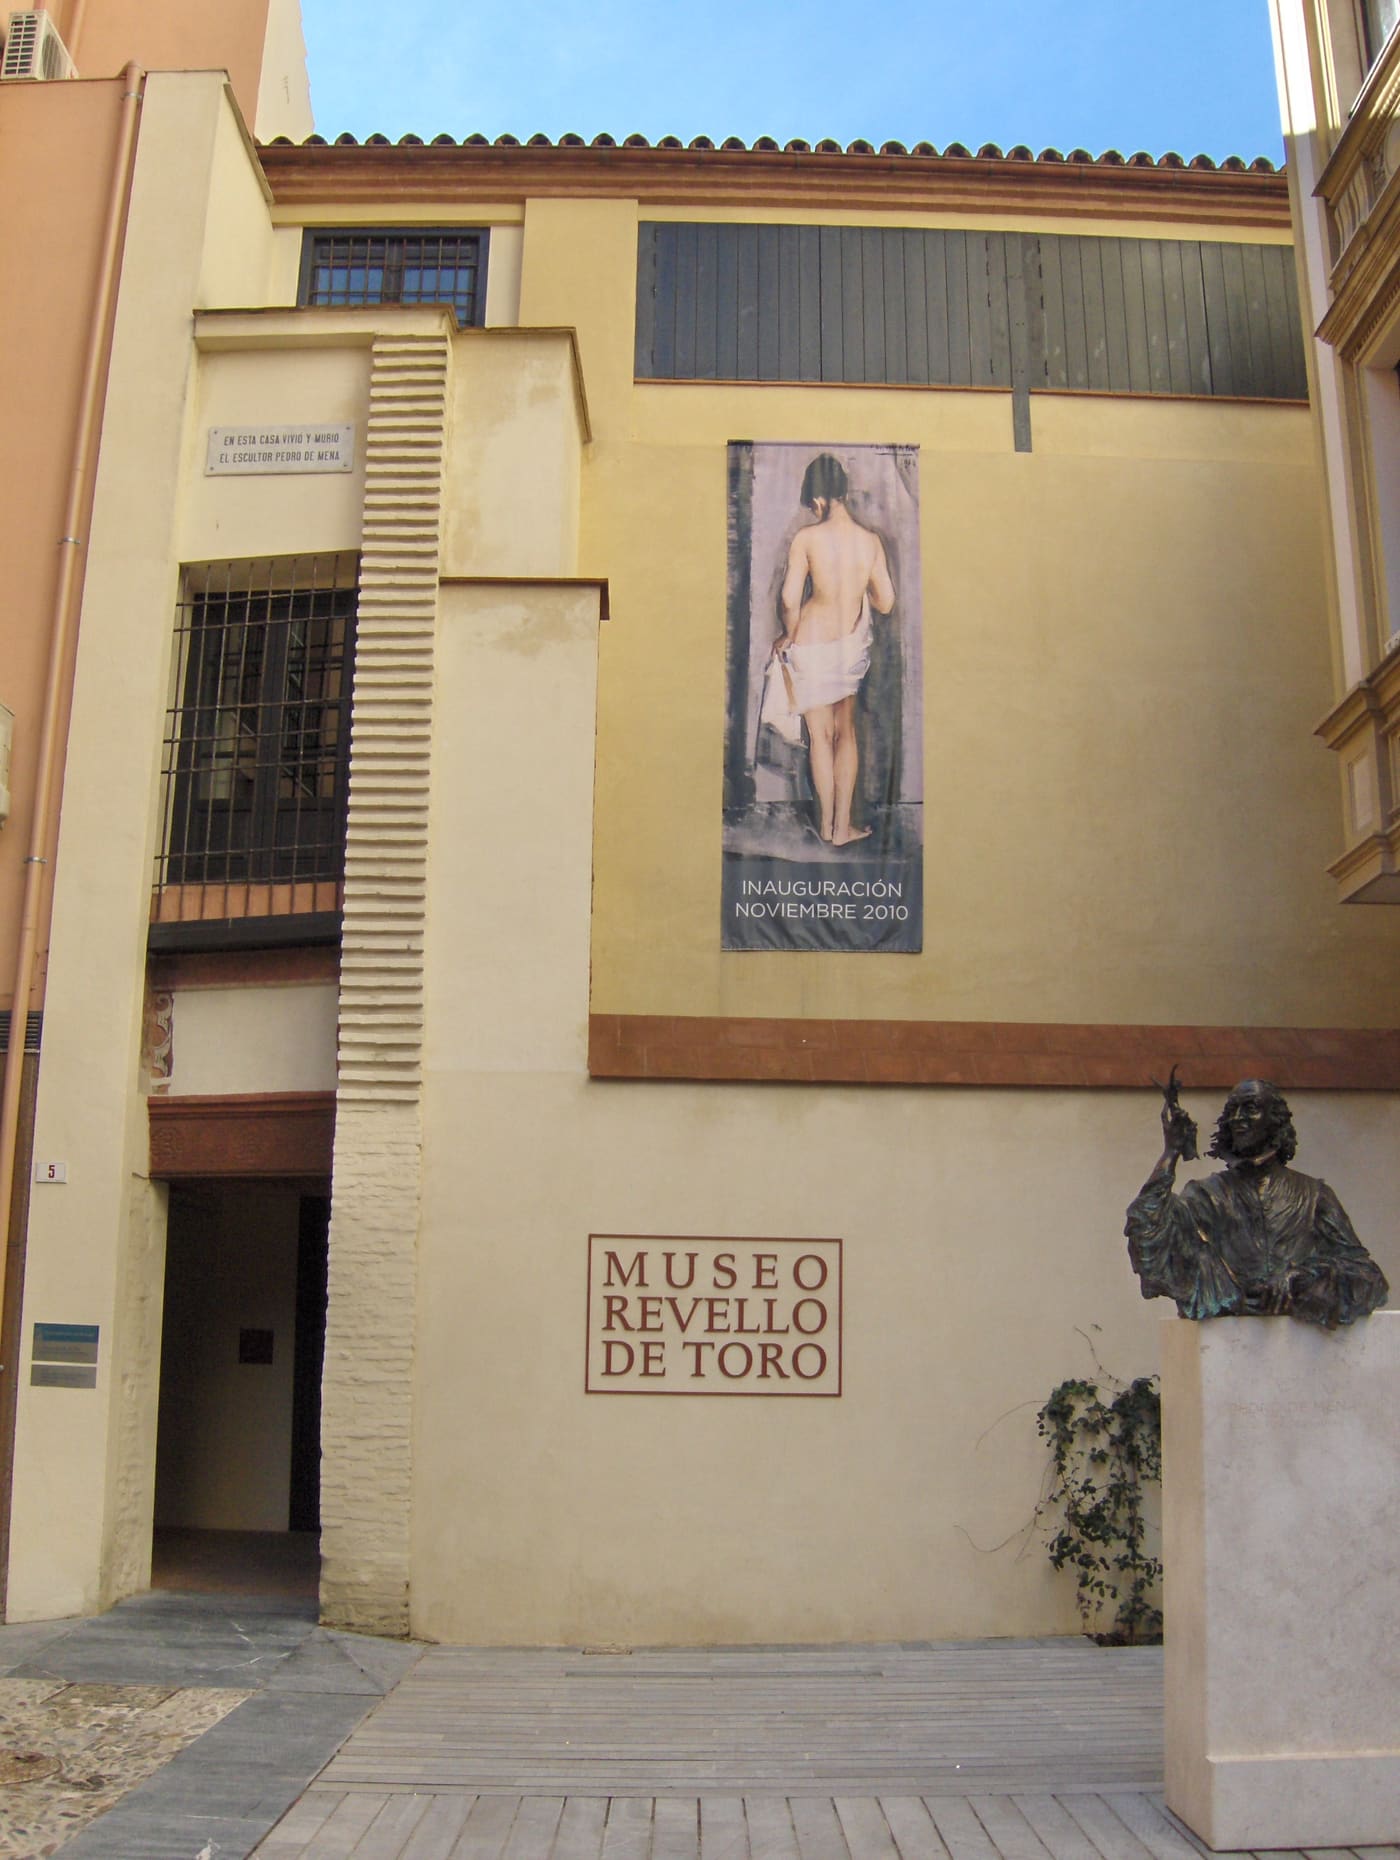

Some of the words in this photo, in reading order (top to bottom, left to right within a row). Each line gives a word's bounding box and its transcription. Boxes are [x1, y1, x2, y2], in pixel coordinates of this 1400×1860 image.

[224, 436, 234, 446] EN
[237, 435, 256, 445] ESTA
[260, 434, 280, 444] CASA
[306, 433, 311, 443] Y
[219, 453, 229, 463] EL
[233, 452, 273, 463] ESCULTOR
[275, 451, 301, 462] PEDRO
[304, 451, 314, 461] DE
[318, 451, 340, 461] MENA
[742, 879, 902, 897] INAUGURACIÓN
[735, 902, 857, 919] NOVIEMBRE
[863, 905, 909, 920] 2010
[48, 1164, 56, 1178] 5
[603, 1251, 828, 1291] MUSEO
[602, 1295, 827, 1335] REVELLO
[601, 1341, 666, 1377] DE
[682, 1342, 827, 1379] TORO
